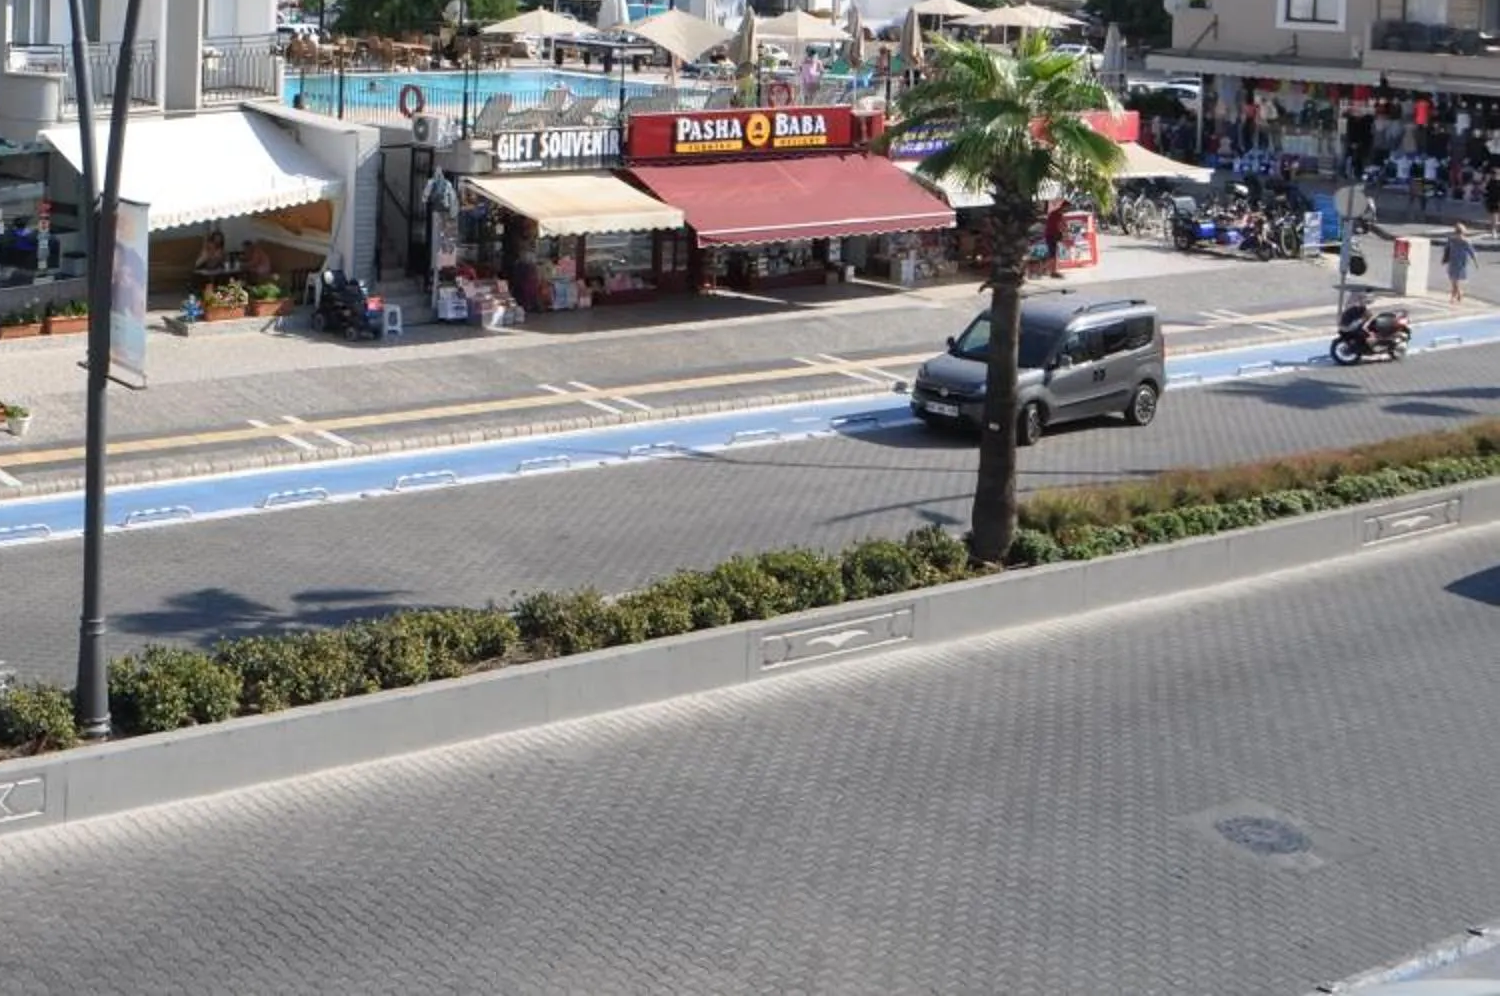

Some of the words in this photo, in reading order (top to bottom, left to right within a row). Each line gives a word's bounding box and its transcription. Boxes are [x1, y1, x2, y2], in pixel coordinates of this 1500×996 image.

[676, 117, 742, 141] PASHA
[774, 112, 826, 136] BABA
[497, 133, 536, 160] GIFT
[539, 130, 620, 159] SOUVENIR
